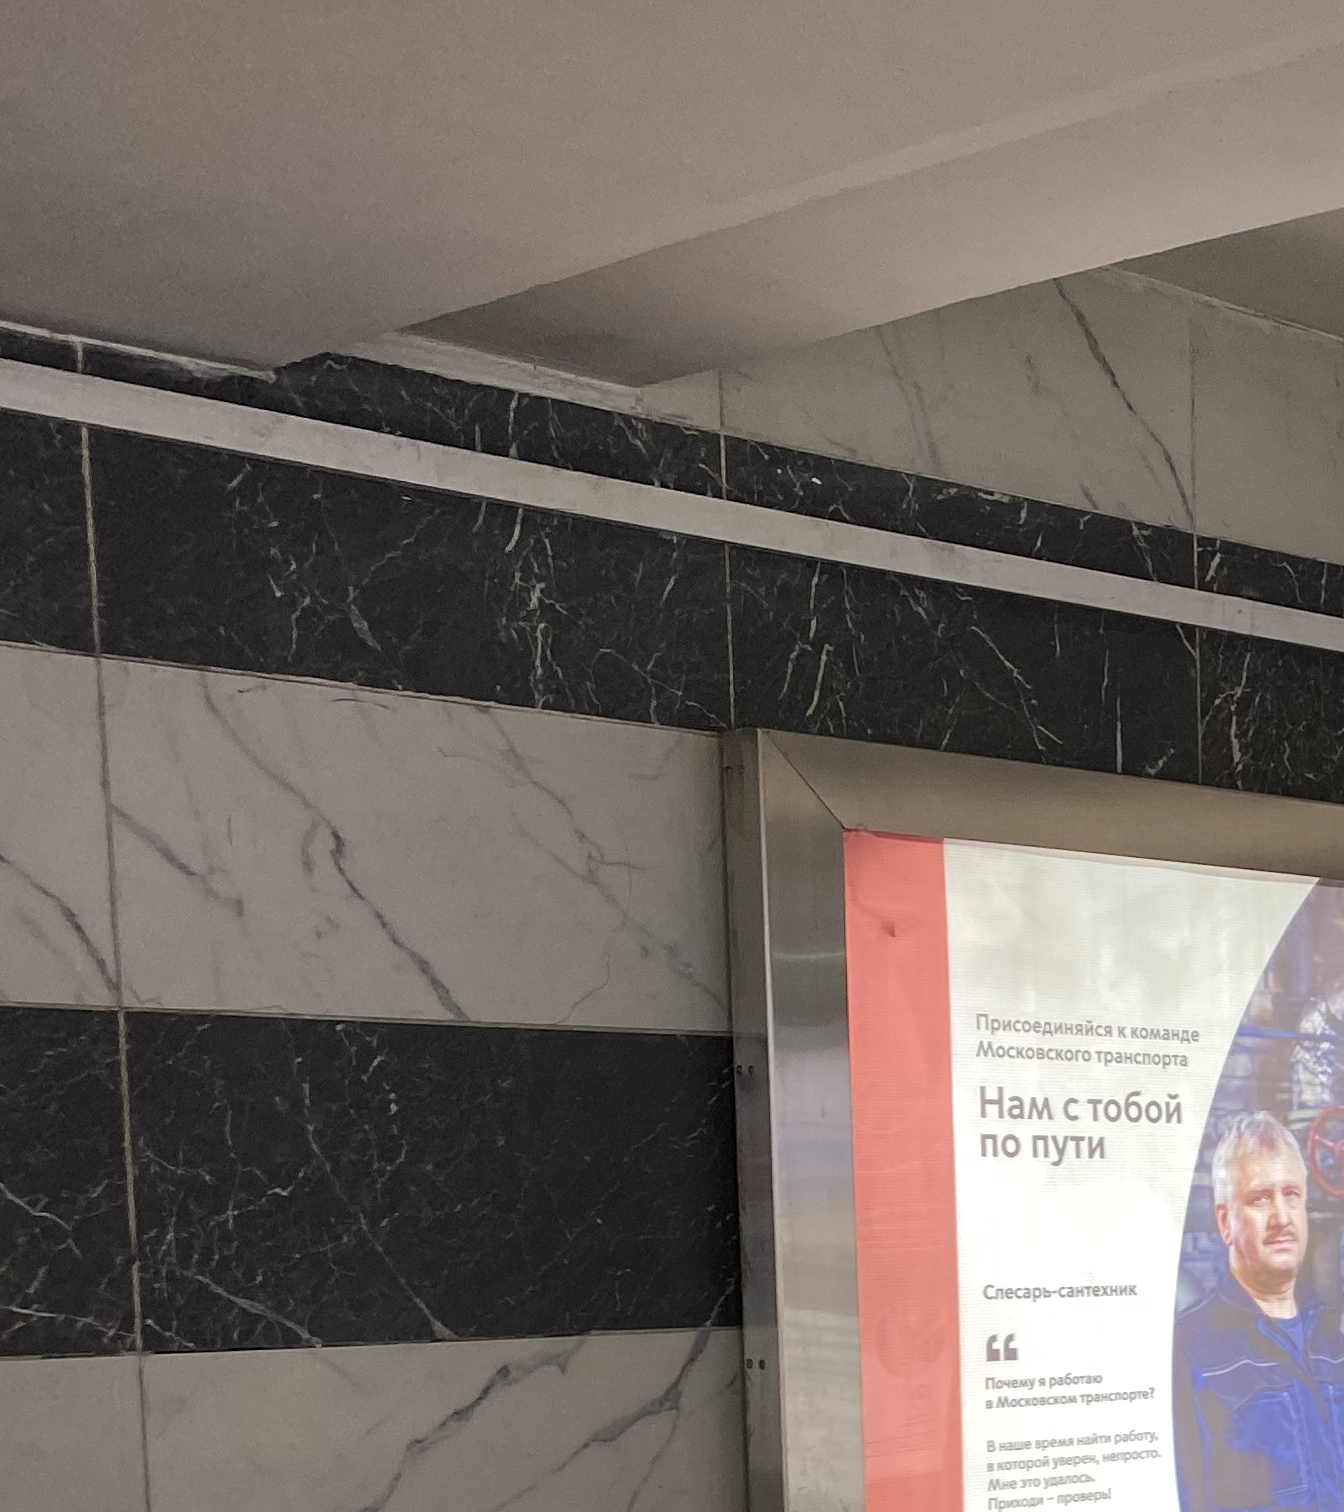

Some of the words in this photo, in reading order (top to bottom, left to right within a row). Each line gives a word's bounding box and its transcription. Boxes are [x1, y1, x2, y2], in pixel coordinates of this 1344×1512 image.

[975, 1013, 1113, 1038] Присоединяйся
[1117, 1025, 1127, 1038] к
[1130, 1027, 1200, 1043] команде
[975, 1041, 1091, 1062] Московского
[1095, 1051, 1188, 1069] транспорта
[979, 1086, 1054, 1120] Нам
[1063, 1097, 1079, 1121] с
[1087, 1090, 1183, 1124] тобой
[980, 1134, 1022, 1157] по
[1032, 1135, 1106, 1166] пути
[983, 1284, 1138, 1302] Слесарь-сантехник
[985, 1376, 1035, 1391] Почему
[1038, 1377, 1046, 1386] я
[1049, 1373, 1103, 1389] работаю
[985, 1399, 993, 1409] в
[996, 1395, 1077, 1409] Московском
[1080, 1387, 1155, 1406] транспорте?
[987, 1440, 995, 1452] В
[999, 1439, 1032, 1451] наше
[1035, 1437, 1074, 1453] время
[1077, 1433, 1112, 1447] найти
[987, 1462, 994, 1472] в
[997, 1455, 1049, 1472] которой
[1052, 1454, 1100, 1470] уверен,
[1102, 1448, 1161, 1464] непросто.
[987, 1479, 1017, 1492] Мне
[1020, 1478, 1041, 1489] это
[1043, 1473, 1096, 1490] удалось.
[988, 1495, 1044, 1512] Приходи
[1057, 1488, 1112, 1506] проверь!
